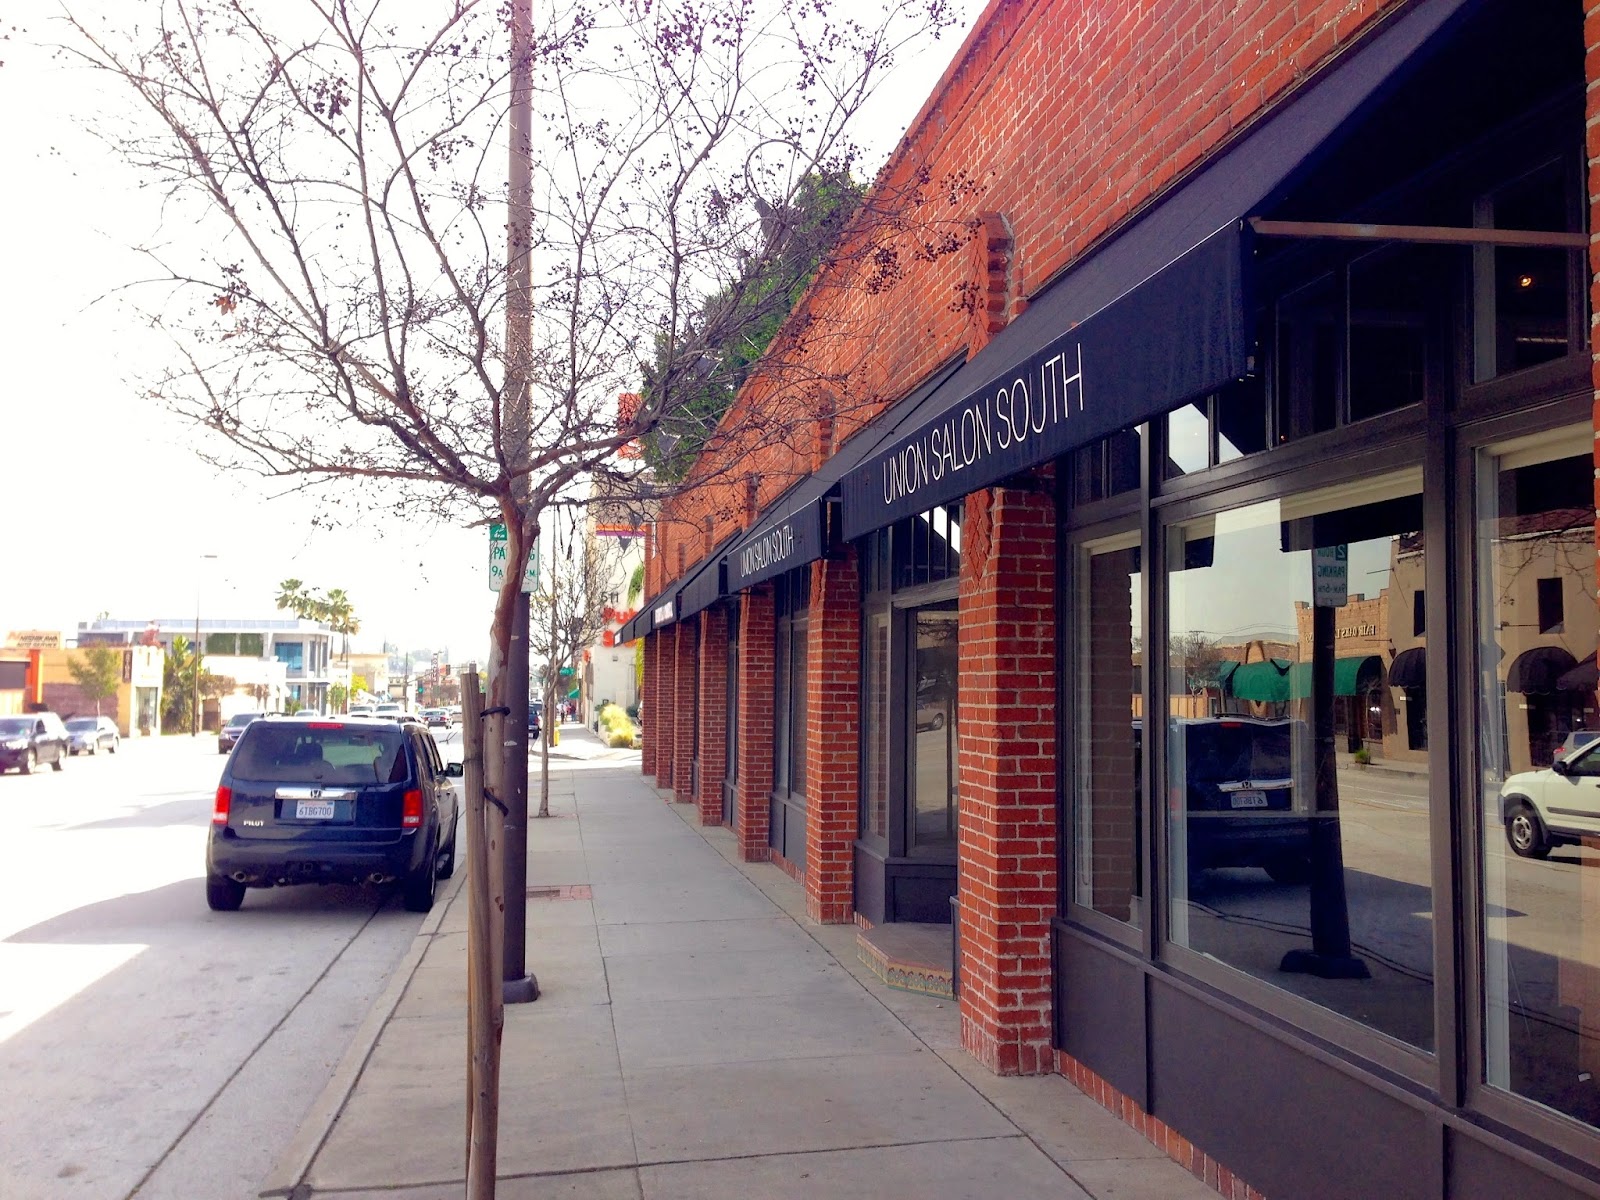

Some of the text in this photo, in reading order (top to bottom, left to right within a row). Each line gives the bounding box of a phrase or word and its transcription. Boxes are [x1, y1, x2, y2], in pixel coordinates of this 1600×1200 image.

[883, 343, 1084, 505] UNION SALON SOUTH
[772, 525, 795, 562] SOUTH
[298, 806, 332, 816] 6TBG700
